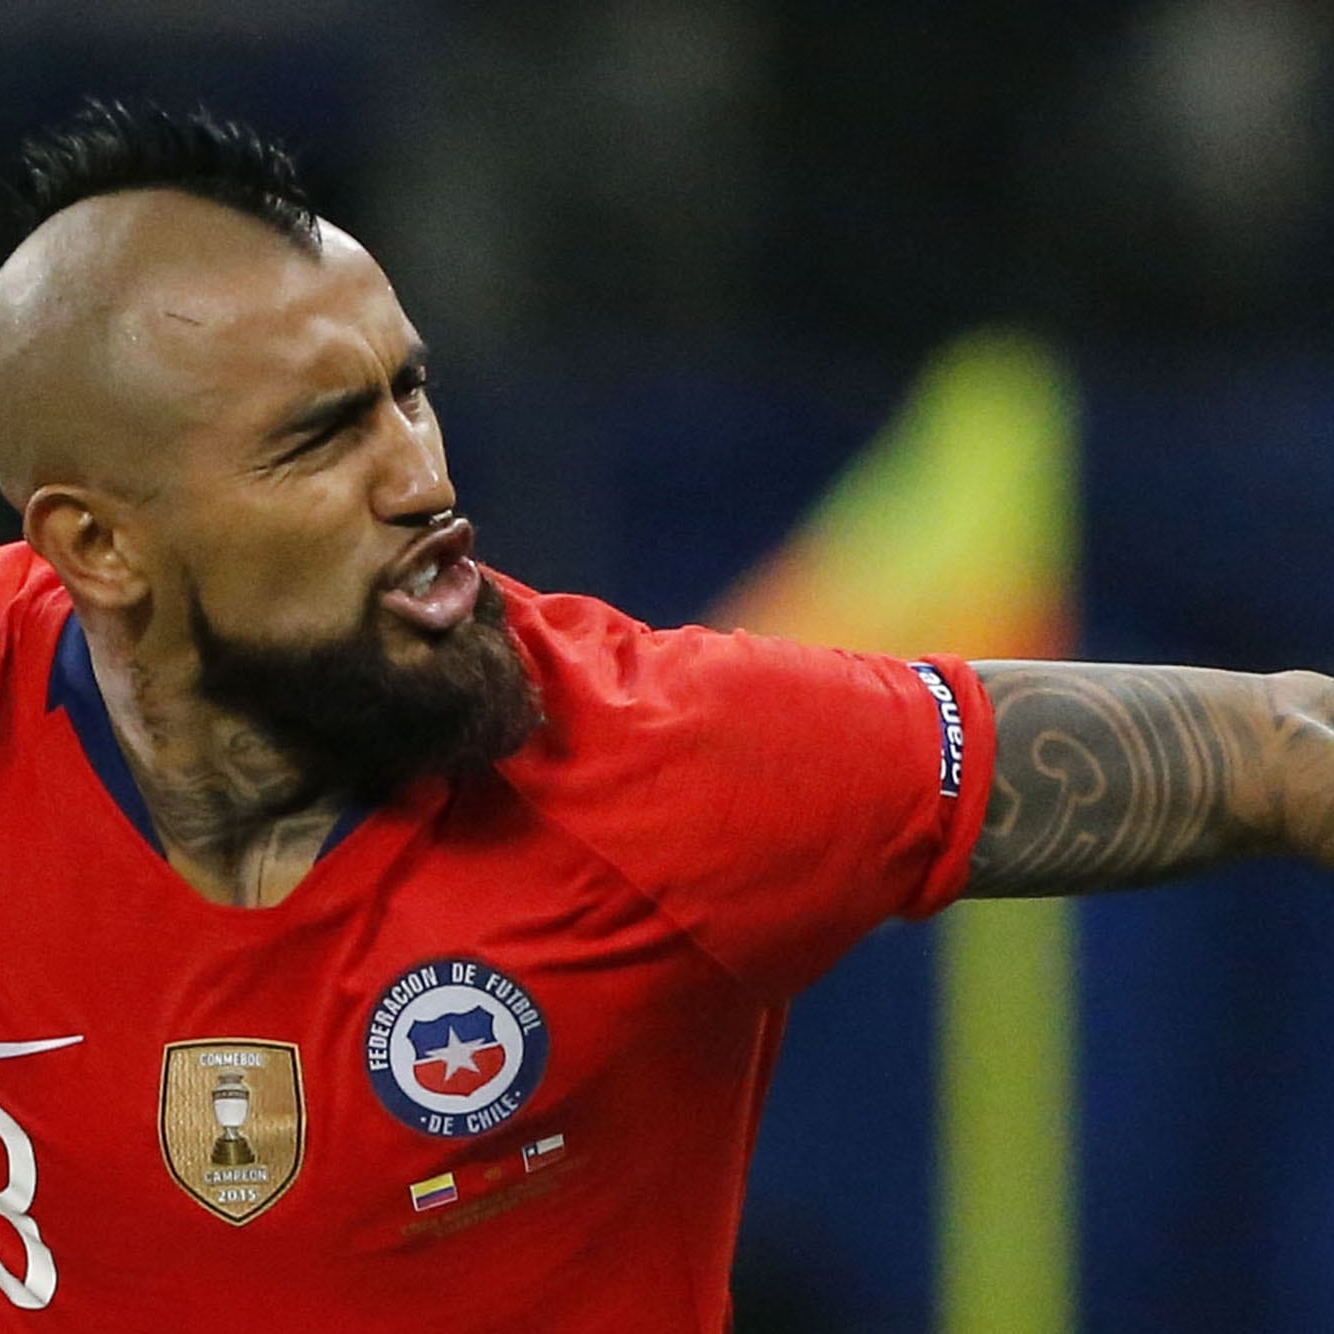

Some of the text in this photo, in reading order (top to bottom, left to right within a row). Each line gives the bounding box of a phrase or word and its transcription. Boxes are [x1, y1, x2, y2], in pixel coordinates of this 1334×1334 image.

[368, 962, 543, 1071] FEDERACION DE FUTBOL
[199, 1052, 264, 1067] CONMEBOL
[427, 1093, 519, 1135] DE CHILE
[218, 1189, 258, 1203] 2015
